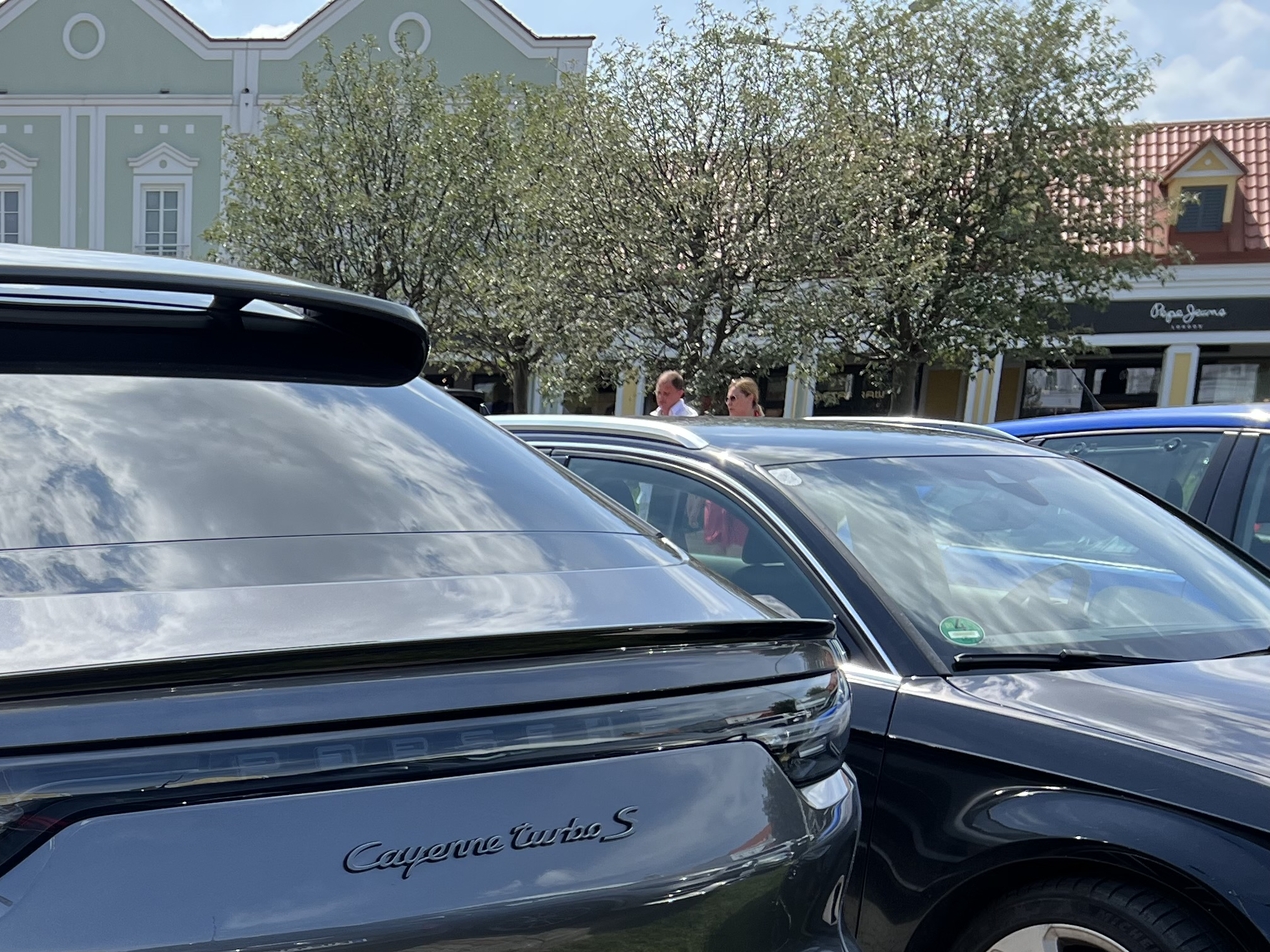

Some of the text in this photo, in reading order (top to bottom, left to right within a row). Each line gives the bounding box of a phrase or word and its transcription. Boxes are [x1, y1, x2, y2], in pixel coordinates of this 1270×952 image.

[1150, 302, 1227, 324] Pepe Jeans
[343, 834, 505, 879] Cayenne
[599, 805, 639, 843] S
